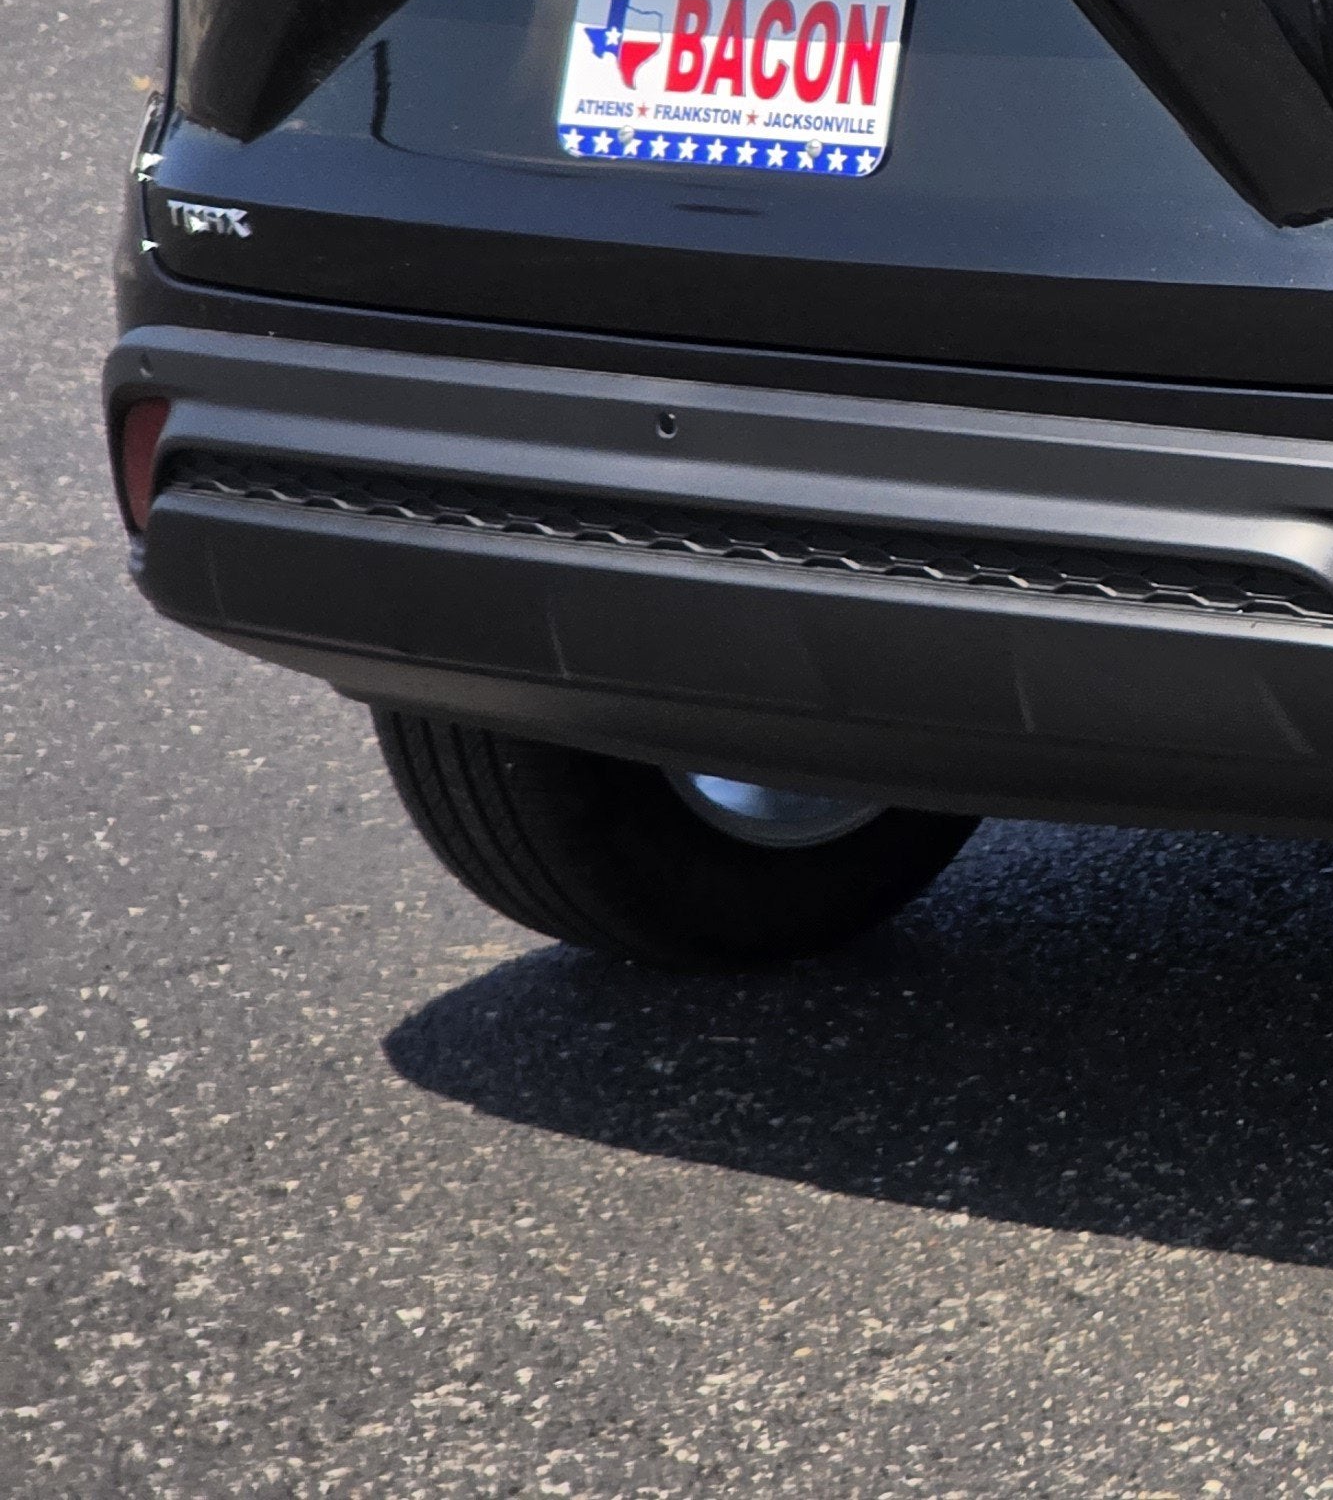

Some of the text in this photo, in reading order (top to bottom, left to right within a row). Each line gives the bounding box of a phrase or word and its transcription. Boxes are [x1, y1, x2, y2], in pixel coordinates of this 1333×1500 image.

[575, 99, 876, 135] ATHENS FRANKSTON JACKSONVILLE
